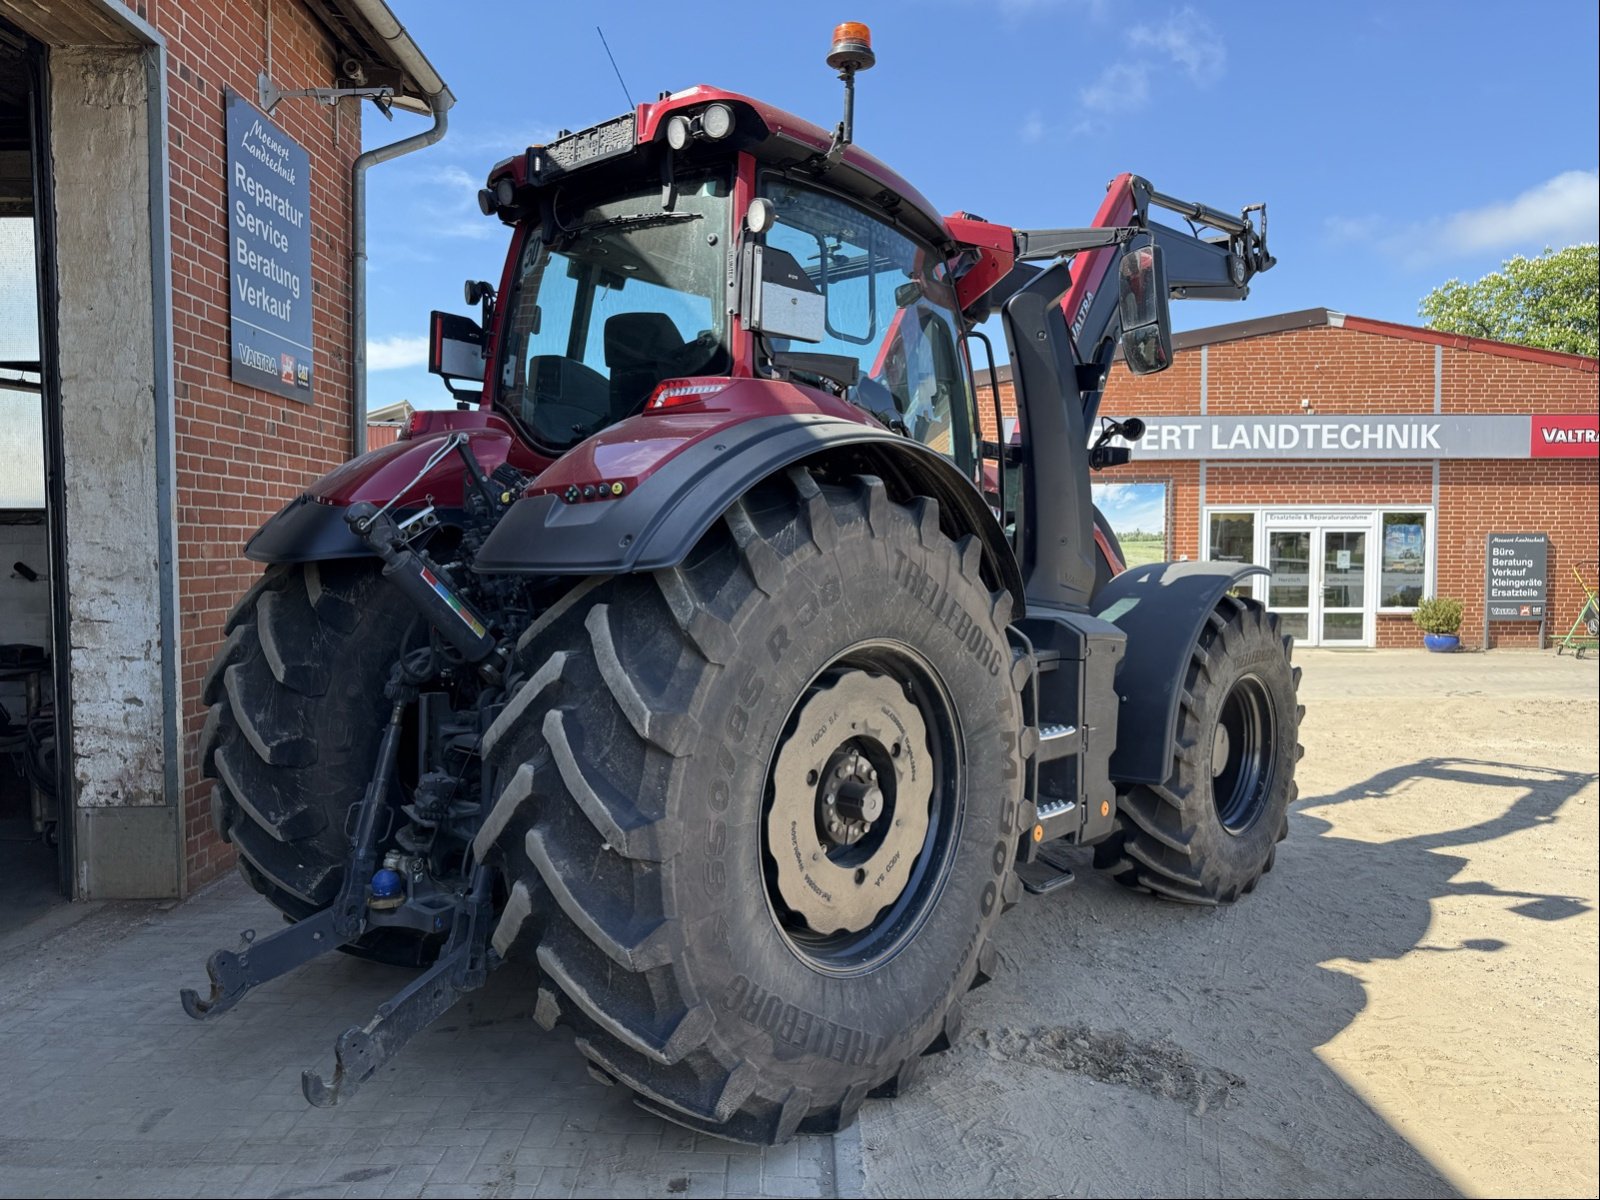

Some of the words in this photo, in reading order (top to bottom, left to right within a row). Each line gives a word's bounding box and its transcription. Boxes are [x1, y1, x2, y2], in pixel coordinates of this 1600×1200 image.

[241, 132, 297, 186] Landtechnik
[250, 119, 290, 161] Moewert
[235, 162, 304, 229] Reparatur
[235, 203, 289, 254] Service
[236, 237, 301, 299] Beratung
[236, 274, 293, 322] Verkauf
[238, 342, 278, 376] VALTRA
[297, 363, 309, 381] CAT
[1211, 424, 1442, 450] LANDTECHNIK
[1492, 547, 1514, 556] Büro
[1492, 558, 1533, 568] Beratung
[1491, 588, 1538, 597] Ersatzteile
[1492, 568, 1526, 577] Verkauf
[1492, 578, 1542, 588] Kleingeräte
[893, 548, 1002, 677] TRELLEBORG
[1491, 607, 1518, 616] VALTRA
[720, 973, 887, 1068] TRELLEBORG
